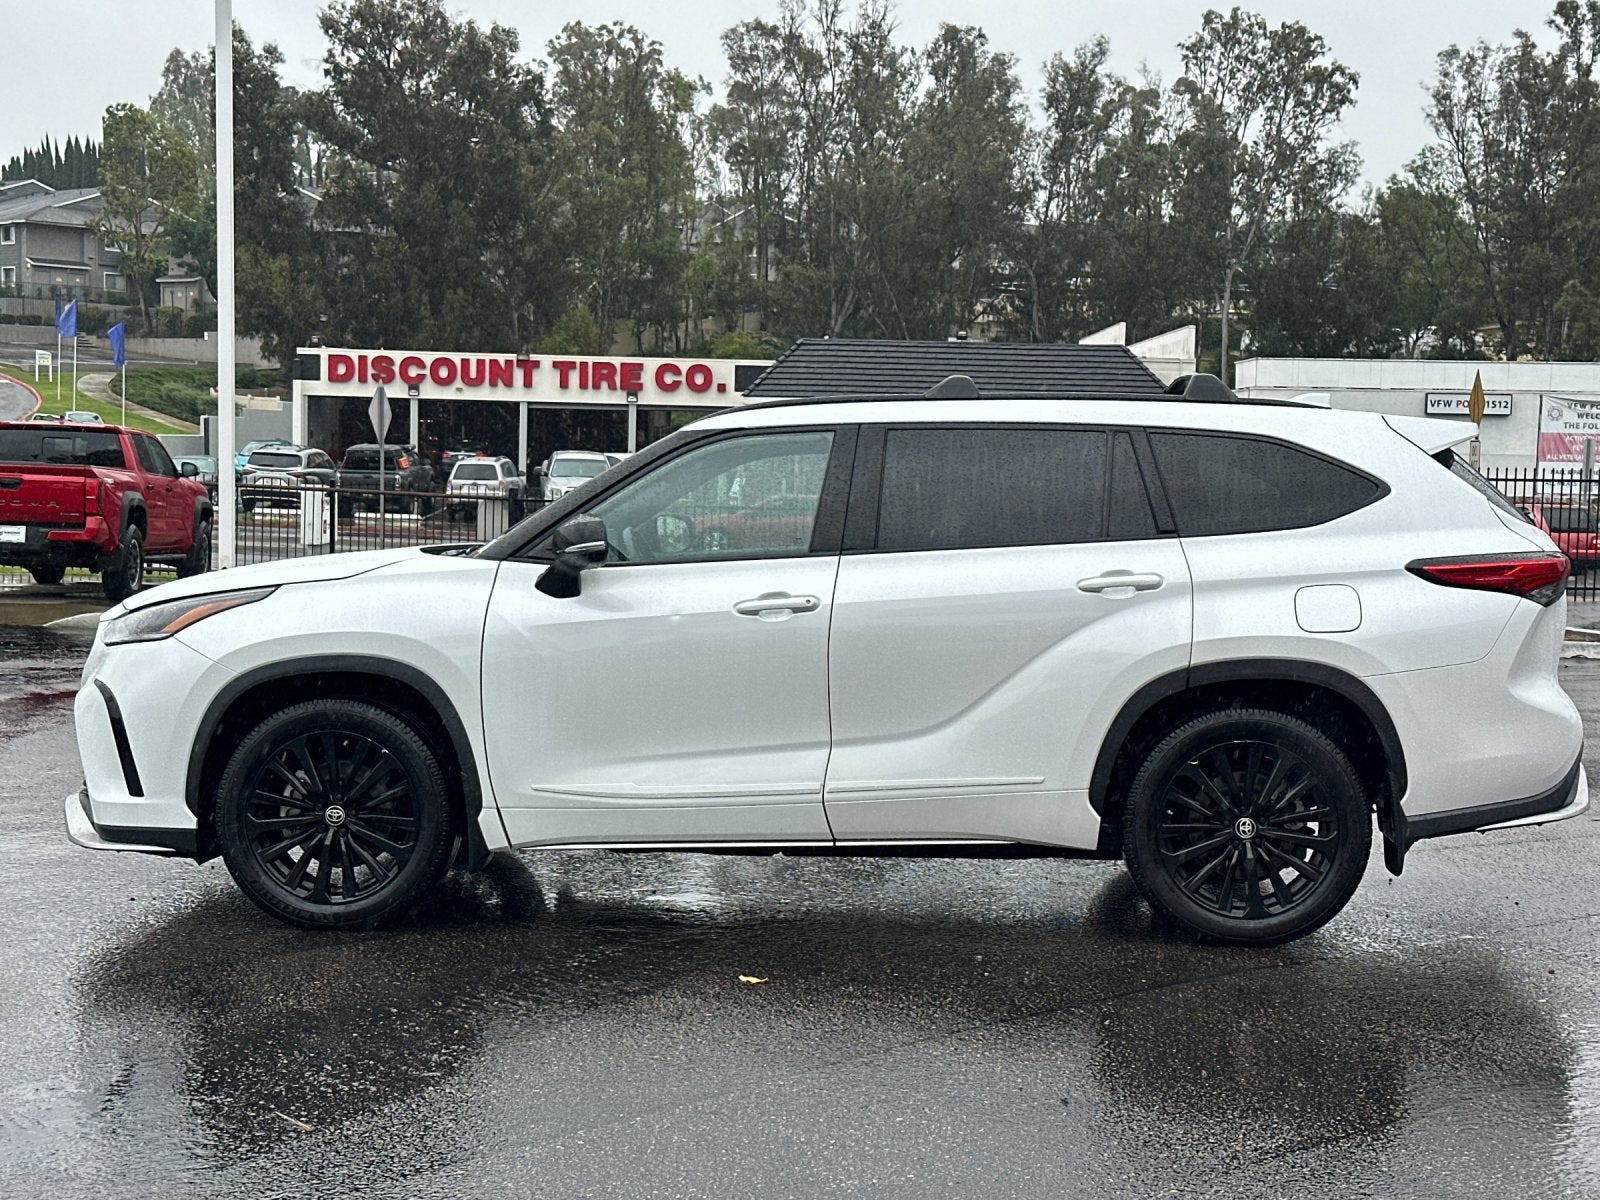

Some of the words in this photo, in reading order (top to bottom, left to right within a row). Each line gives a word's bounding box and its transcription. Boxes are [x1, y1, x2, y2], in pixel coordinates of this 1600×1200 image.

[327, 354, 541, 388] DISCOUNT
[552, 360, 644, 391] TIRE
[654, 363, 727, 393] CO.
[1430, 399, 1453, 408] VFW
[1456, 400, 1470, 408] PO
[1486, 401, 1509, 409] 1512
[1567, 402, 1588, 410] VFW
[1563, 422, 1580, 430] THE
